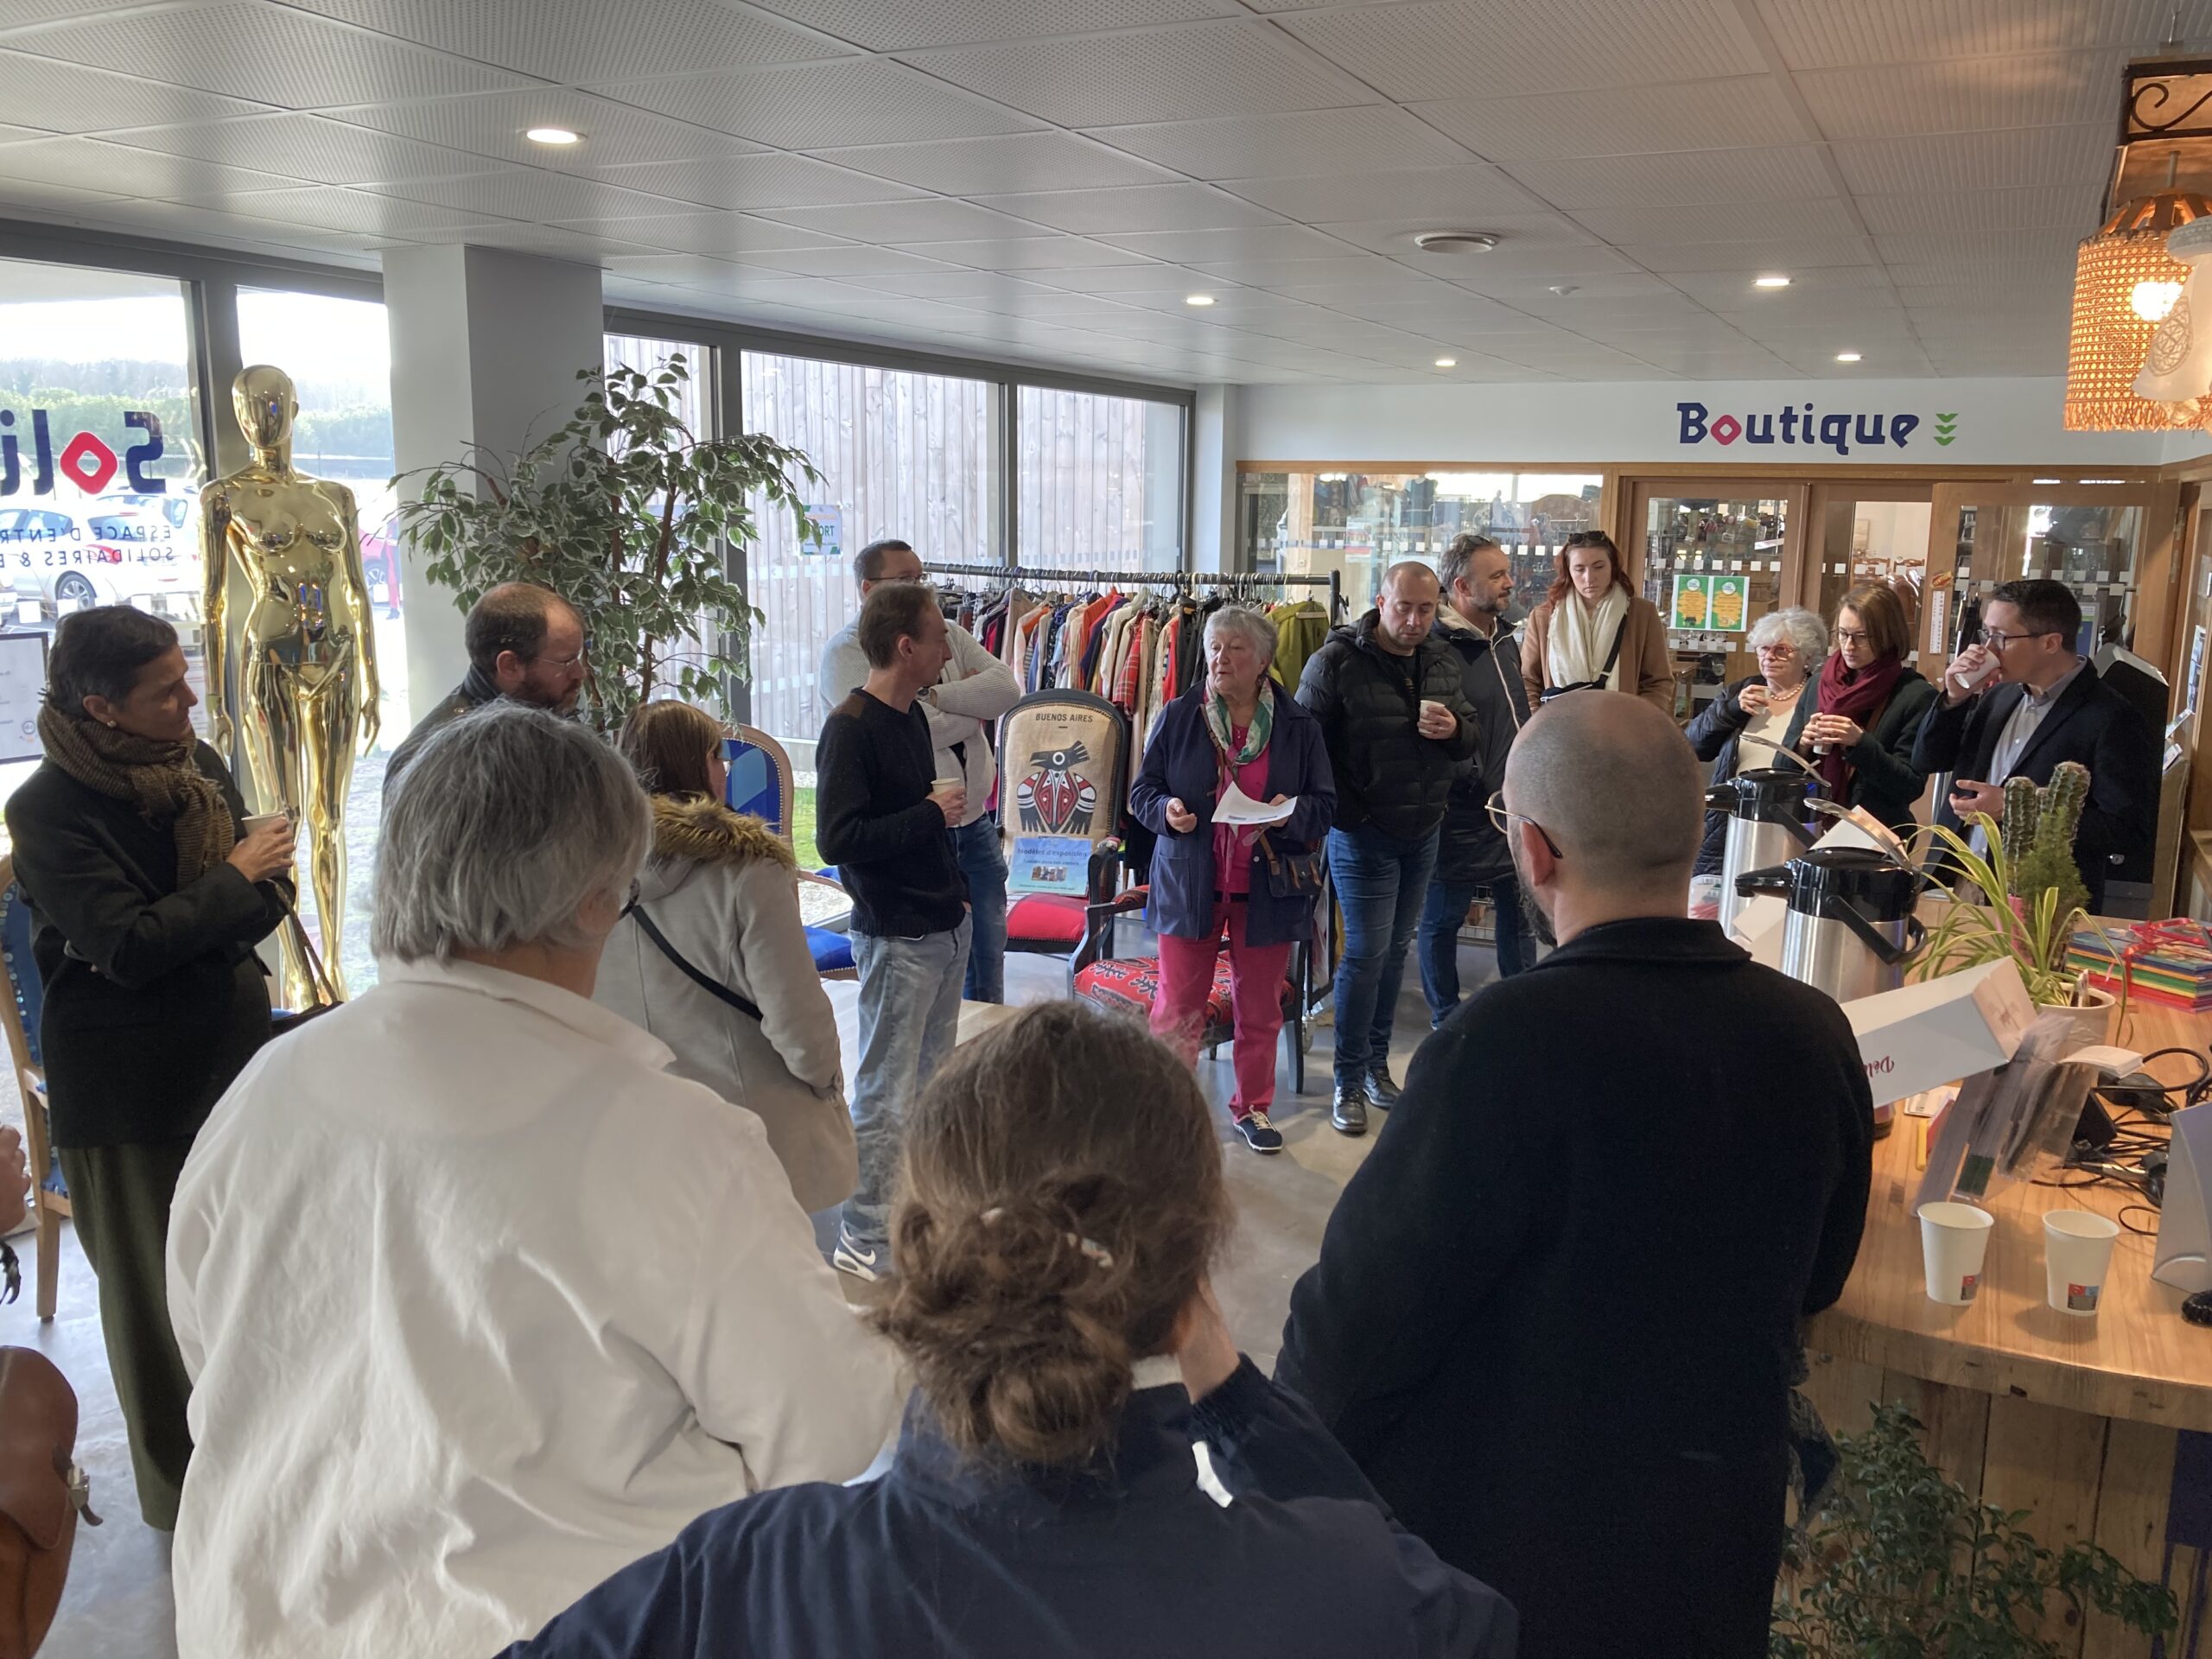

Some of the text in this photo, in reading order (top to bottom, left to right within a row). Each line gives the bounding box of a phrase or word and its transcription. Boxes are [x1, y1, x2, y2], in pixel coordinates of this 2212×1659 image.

[1676, 403, 1919, 455] Boutique
[1035, 713, 1093, 722] BUENOS AIRES
[1046, 849, 1088, 858] d'exposition
